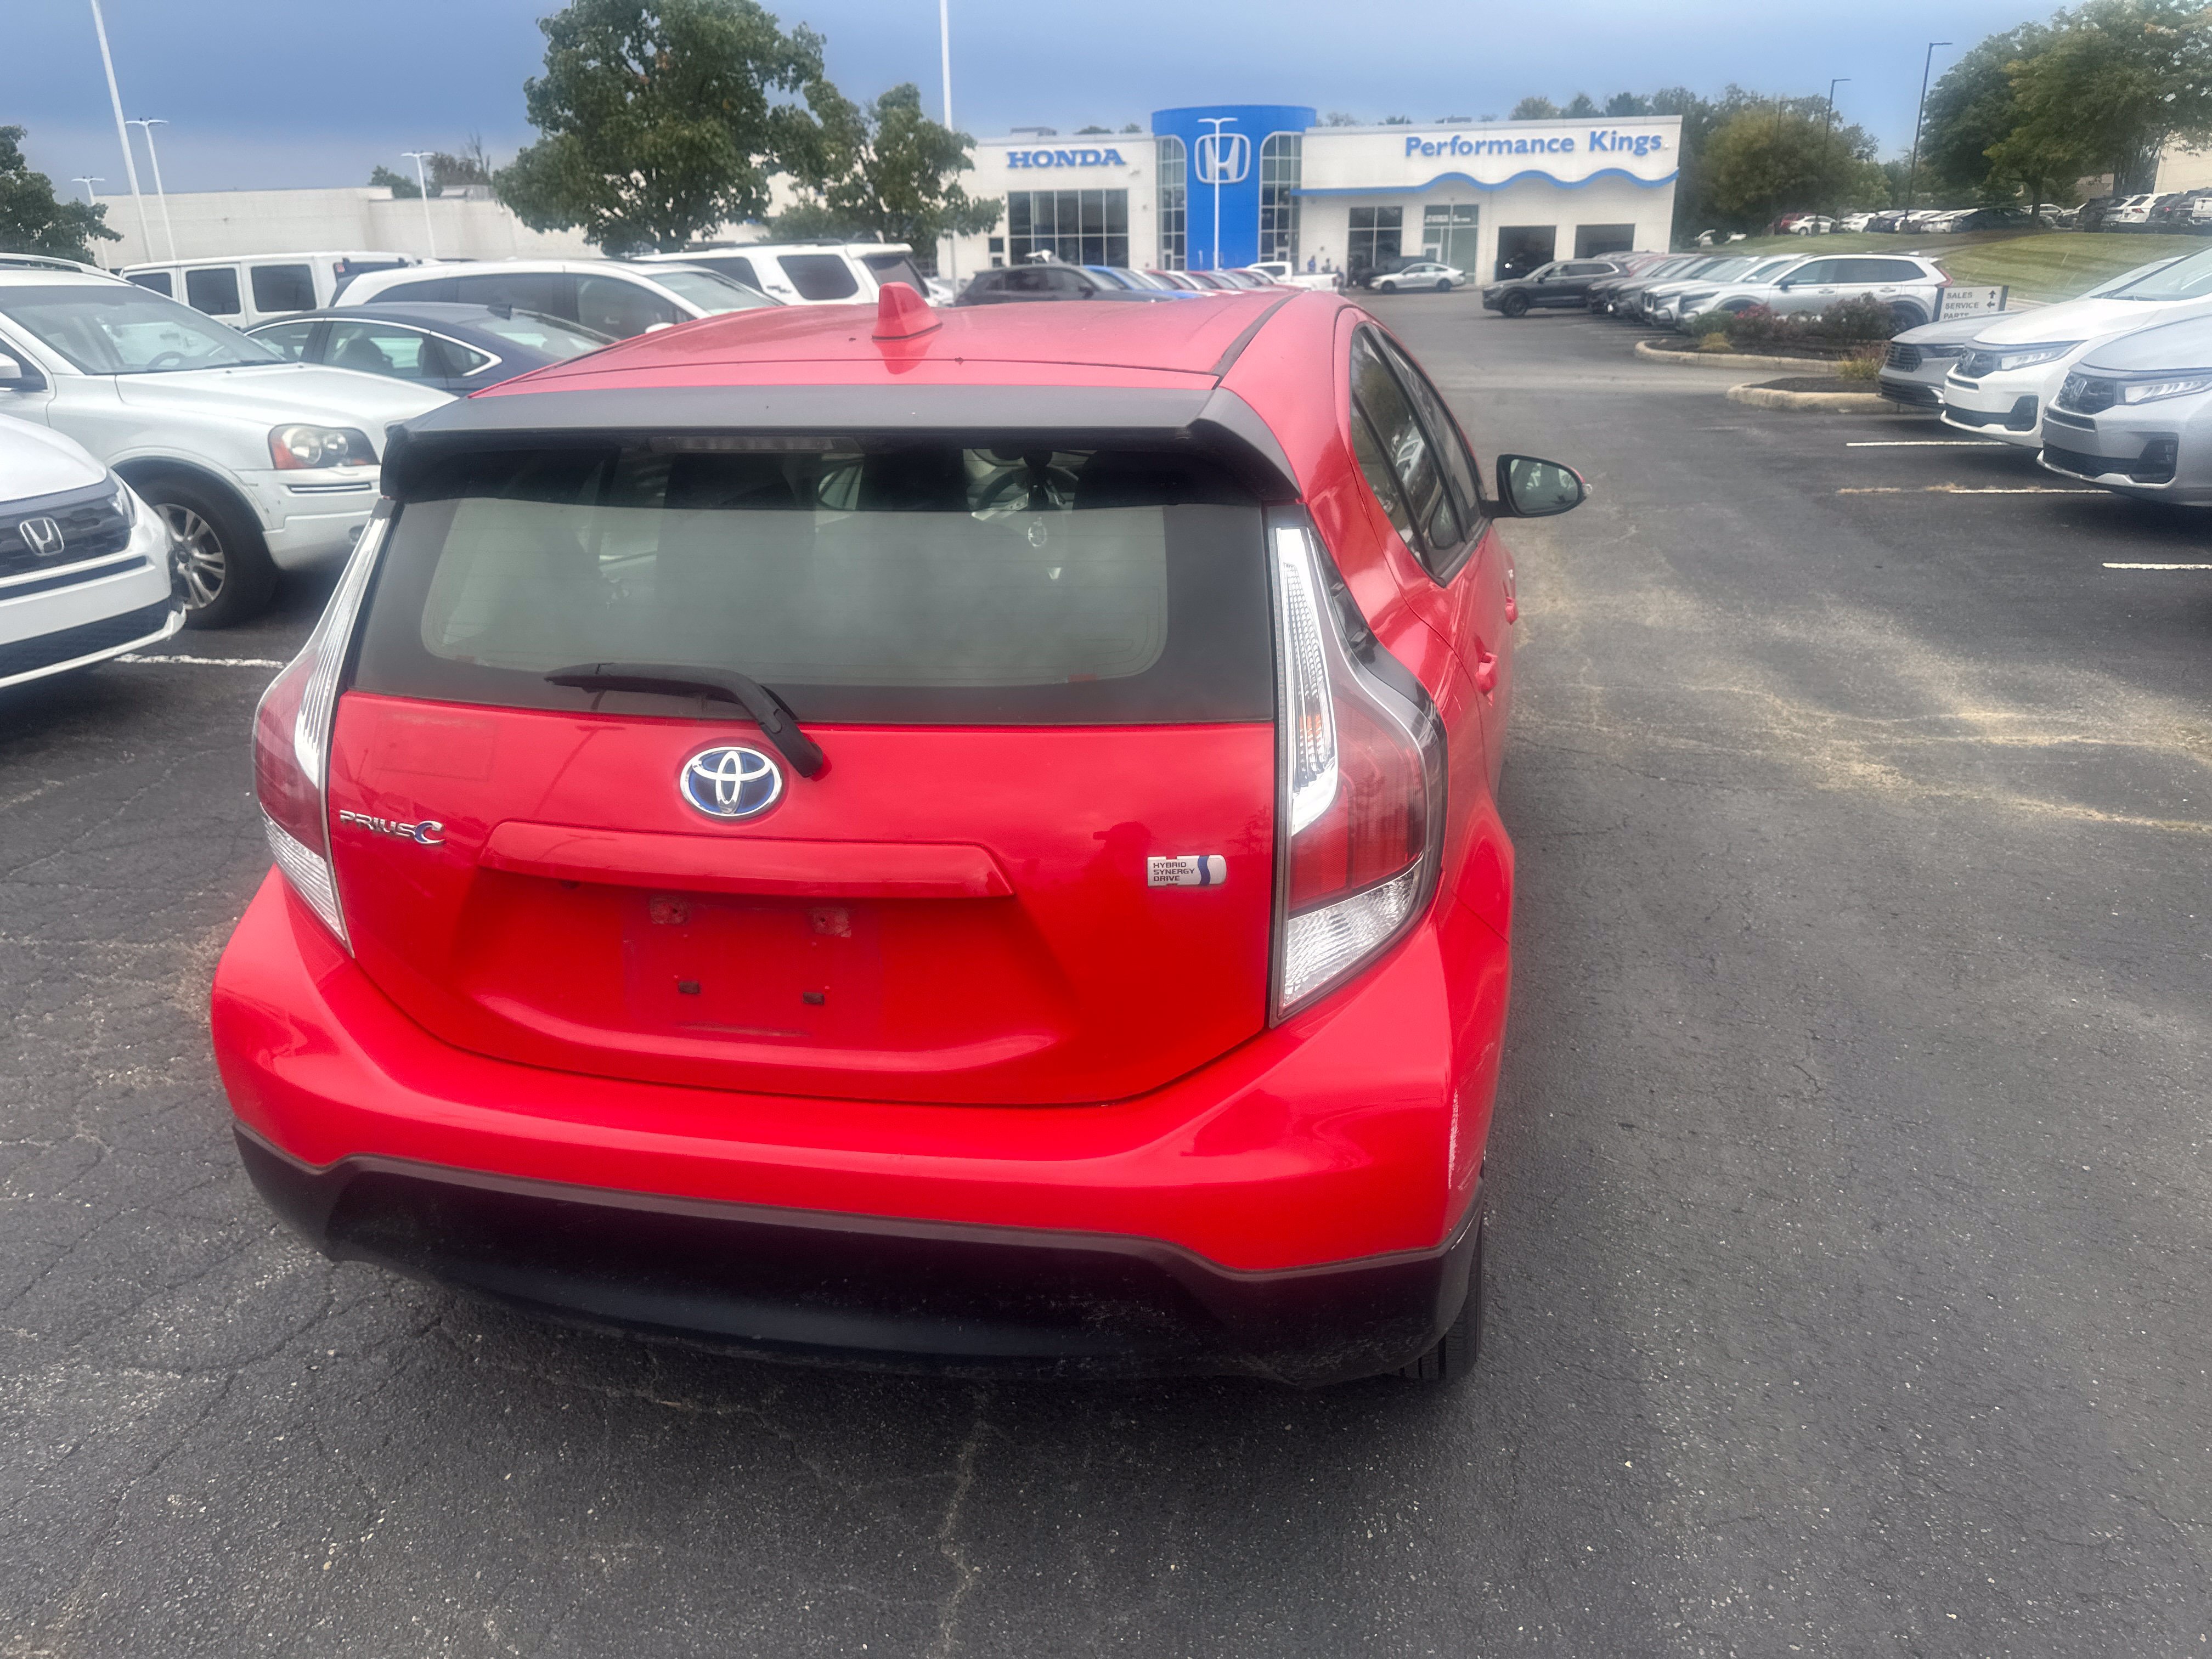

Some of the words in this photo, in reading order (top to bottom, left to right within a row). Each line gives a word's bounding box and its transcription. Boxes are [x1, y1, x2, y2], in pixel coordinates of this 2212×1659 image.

[1405, 135, 1574, 157] Performance
[1589, 131, 1662, 156] Kings
[1007, 148, 1127, 169] HONDA
[340, 809, 415, 837] PRIUS
